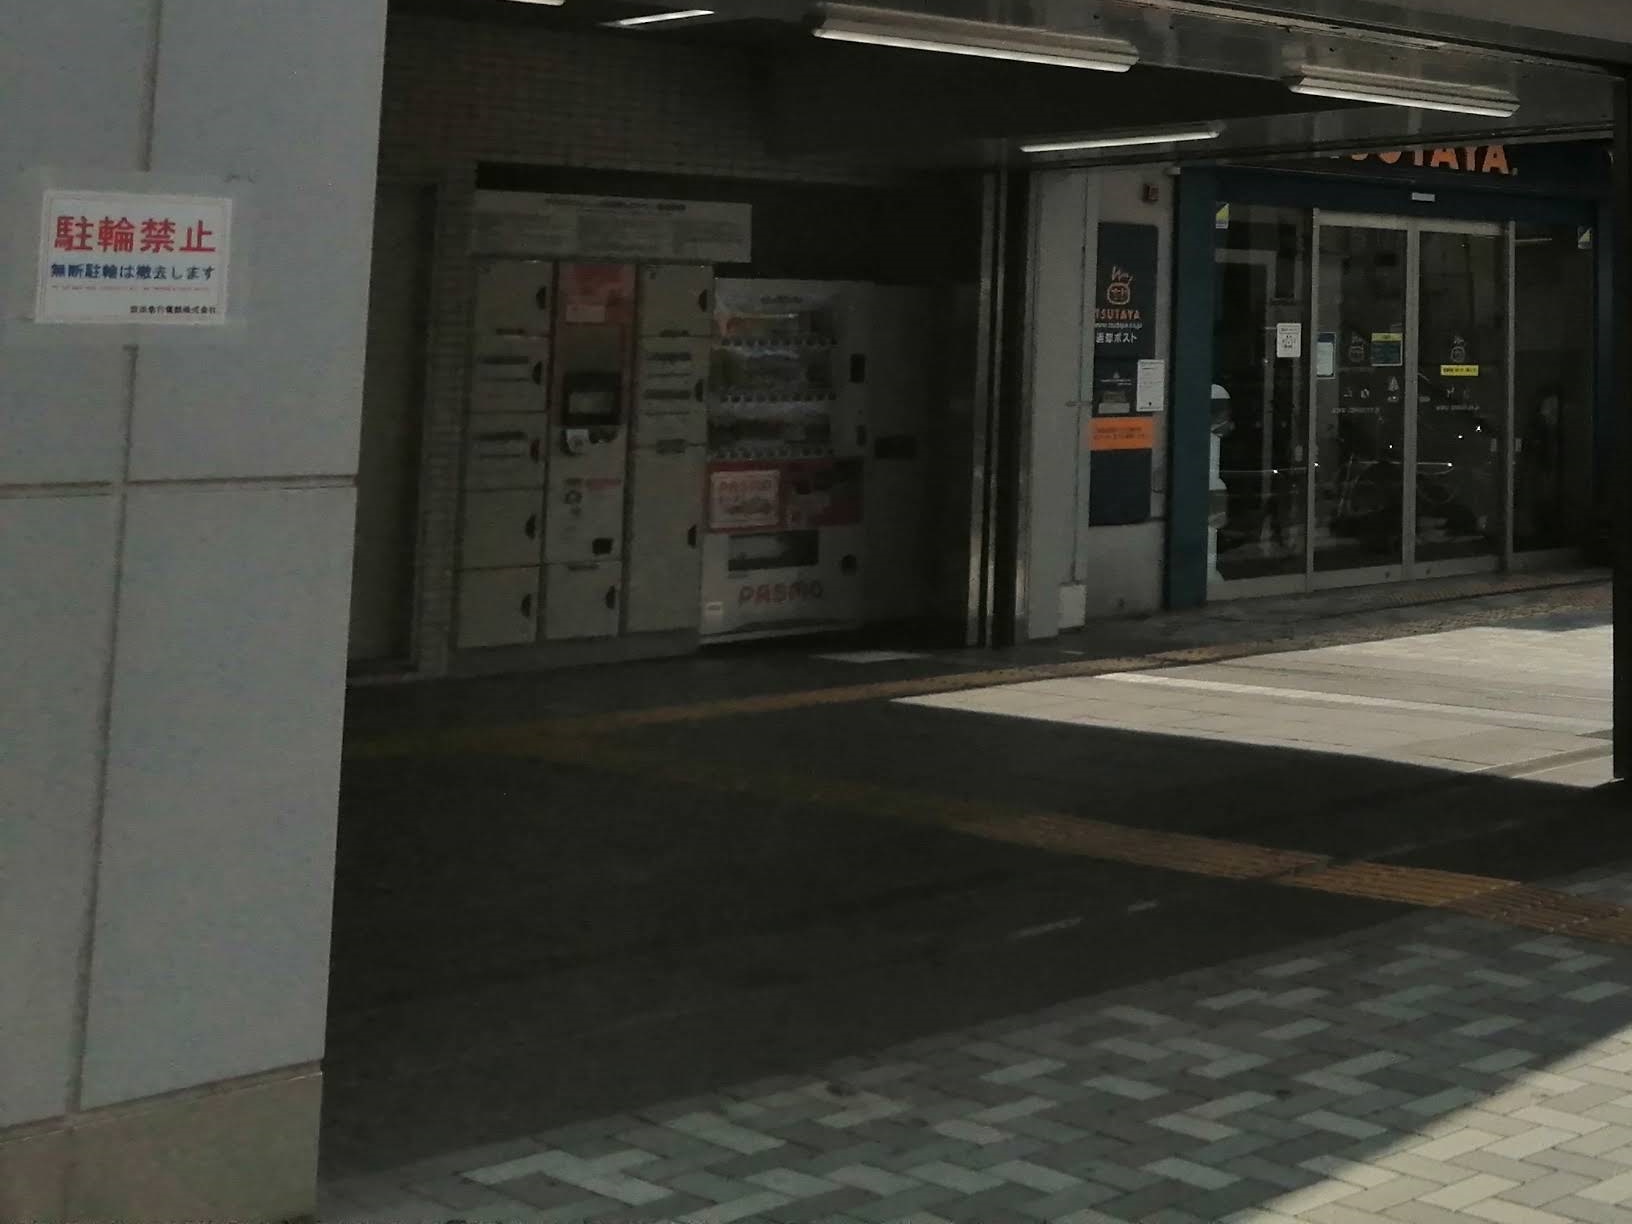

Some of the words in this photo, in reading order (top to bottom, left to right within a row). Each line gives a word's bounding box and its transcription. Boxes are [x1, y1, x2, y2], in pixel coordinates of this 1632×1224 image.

[53, 215, 217, 254] 駐輪禁止
[50, 262, 216, 281] 無断駐輪は撤去します
